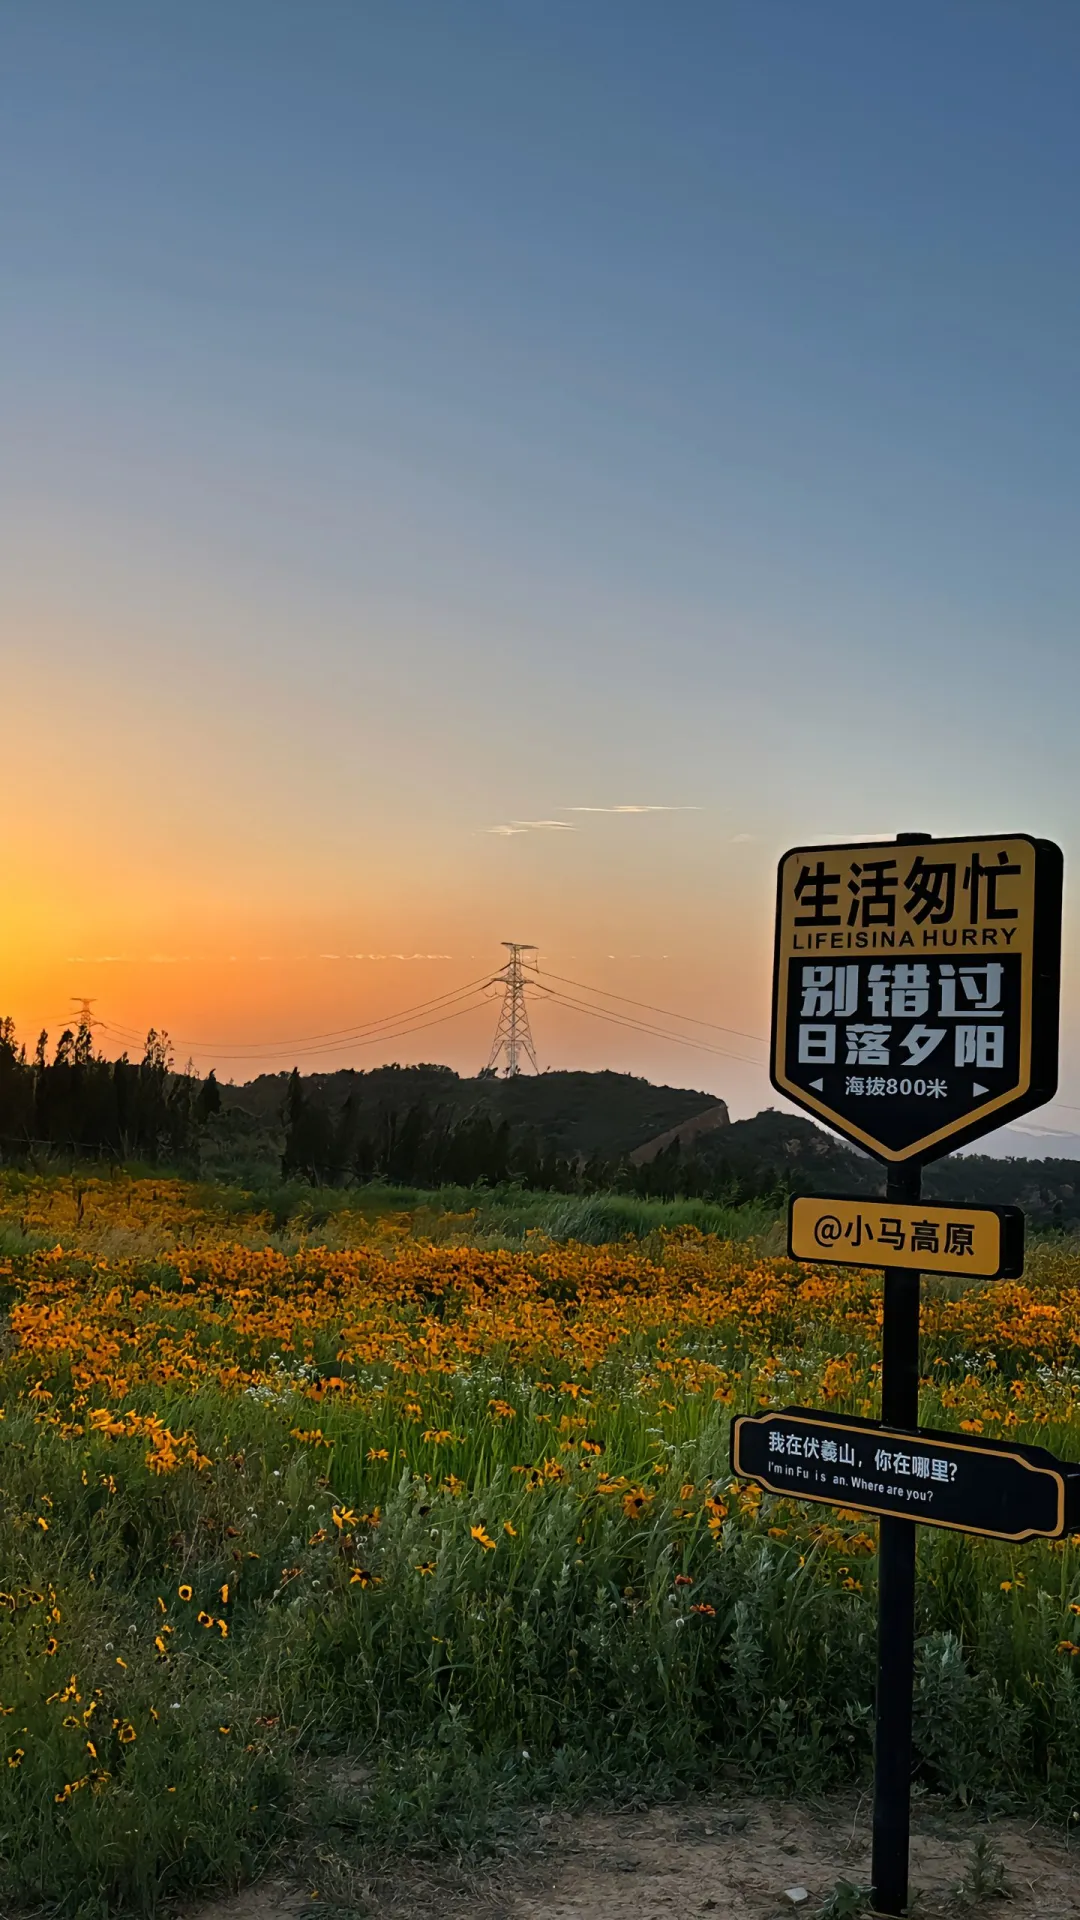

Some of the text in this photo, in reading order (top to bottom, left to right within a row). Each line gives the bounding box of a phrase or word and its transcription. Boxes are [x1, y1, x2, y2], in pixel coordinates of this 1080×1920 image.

[794, 853, 1021, 927] 生活匆忙
[923, 927, 1017, 947] HURRY
[800, 963, 1004, 1017] 别错过
[798, 1024, 1004, 1068] 日落夕阳
[845, 1076, 948, 1099] 海拔800米
[814, 1215, 975, 1256] @小马高原
[768, 1461, 783, 1474] I'm
[785, 1464, 794, 1476] in
[796, 1466, 809, 1479] Fu
[851, 1476, 884, 1493] Where
[886, 1485, 904, 1497] are
[906, 1489, 934, 1502] you?
